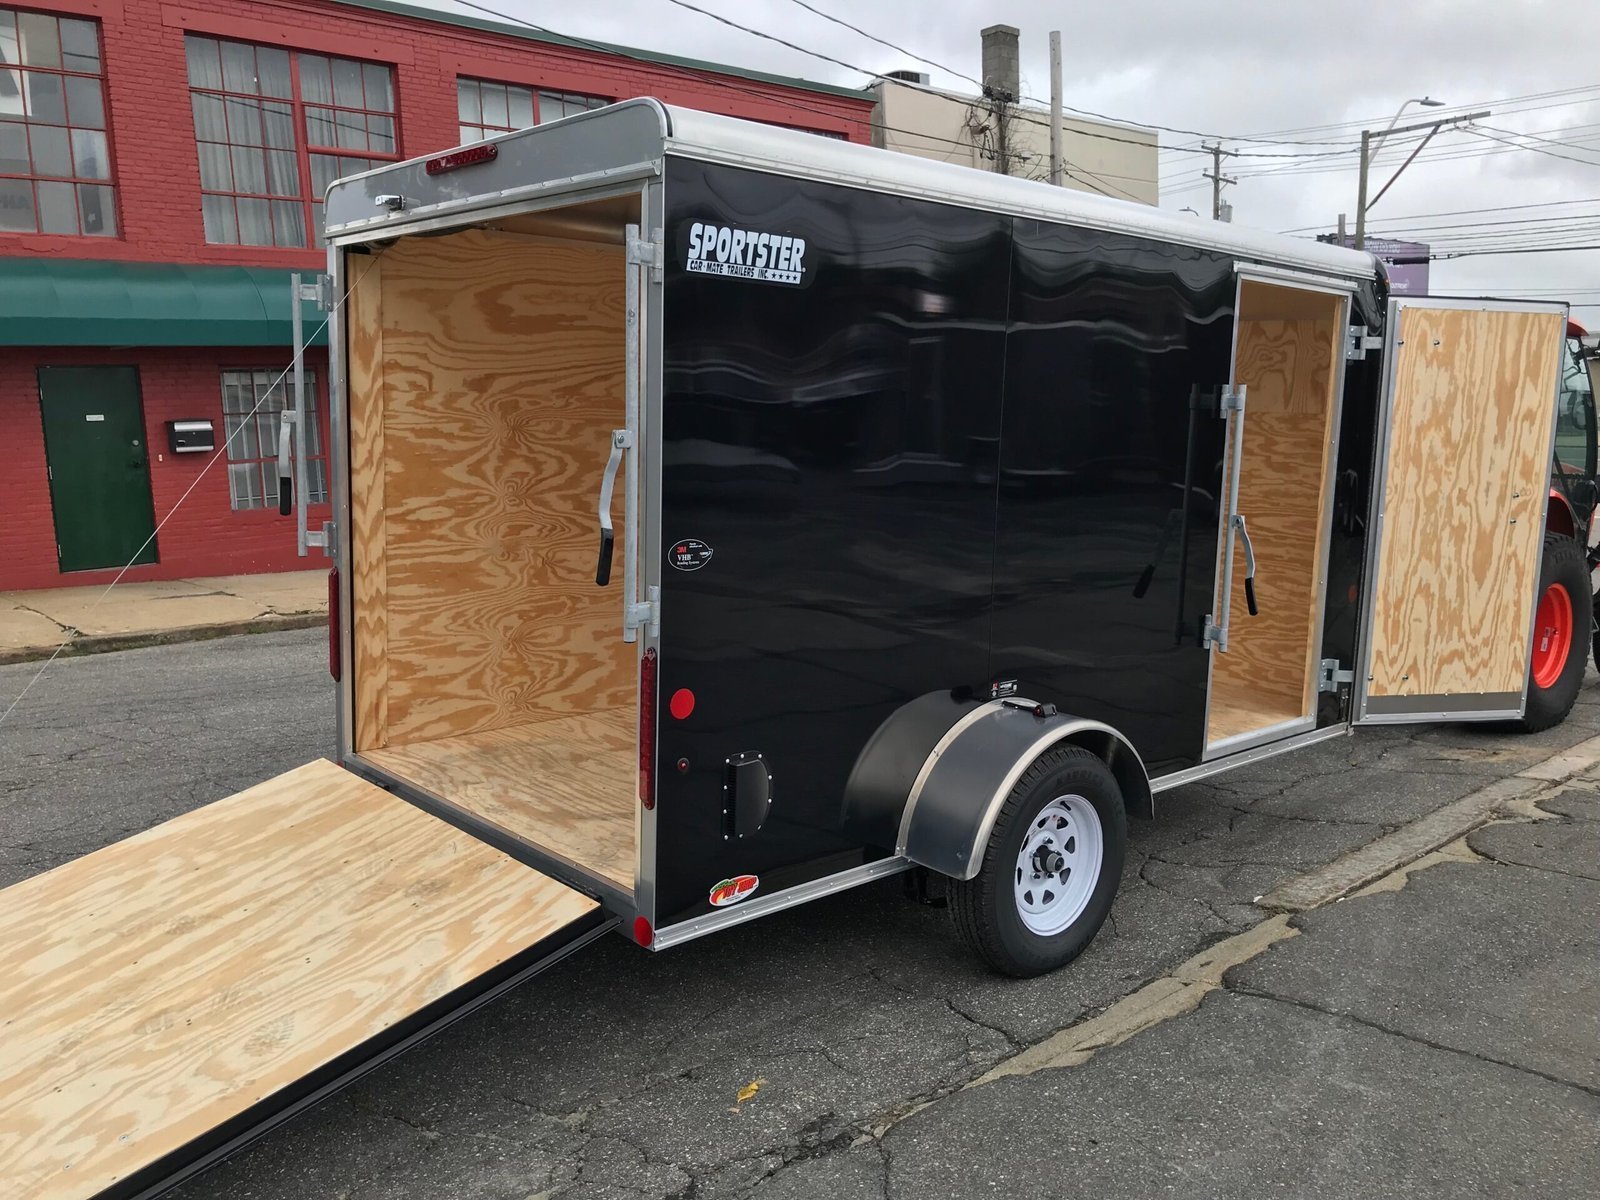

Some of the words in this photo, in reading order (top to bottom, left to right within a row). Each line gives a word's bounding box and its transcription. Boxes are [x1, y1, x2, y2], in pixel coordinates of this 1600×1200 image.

[688, 222, 806, 272] SPORTSTER
[727, 265, 755, 278] TRAILERS
[757, 269, 769, 279] INC.
